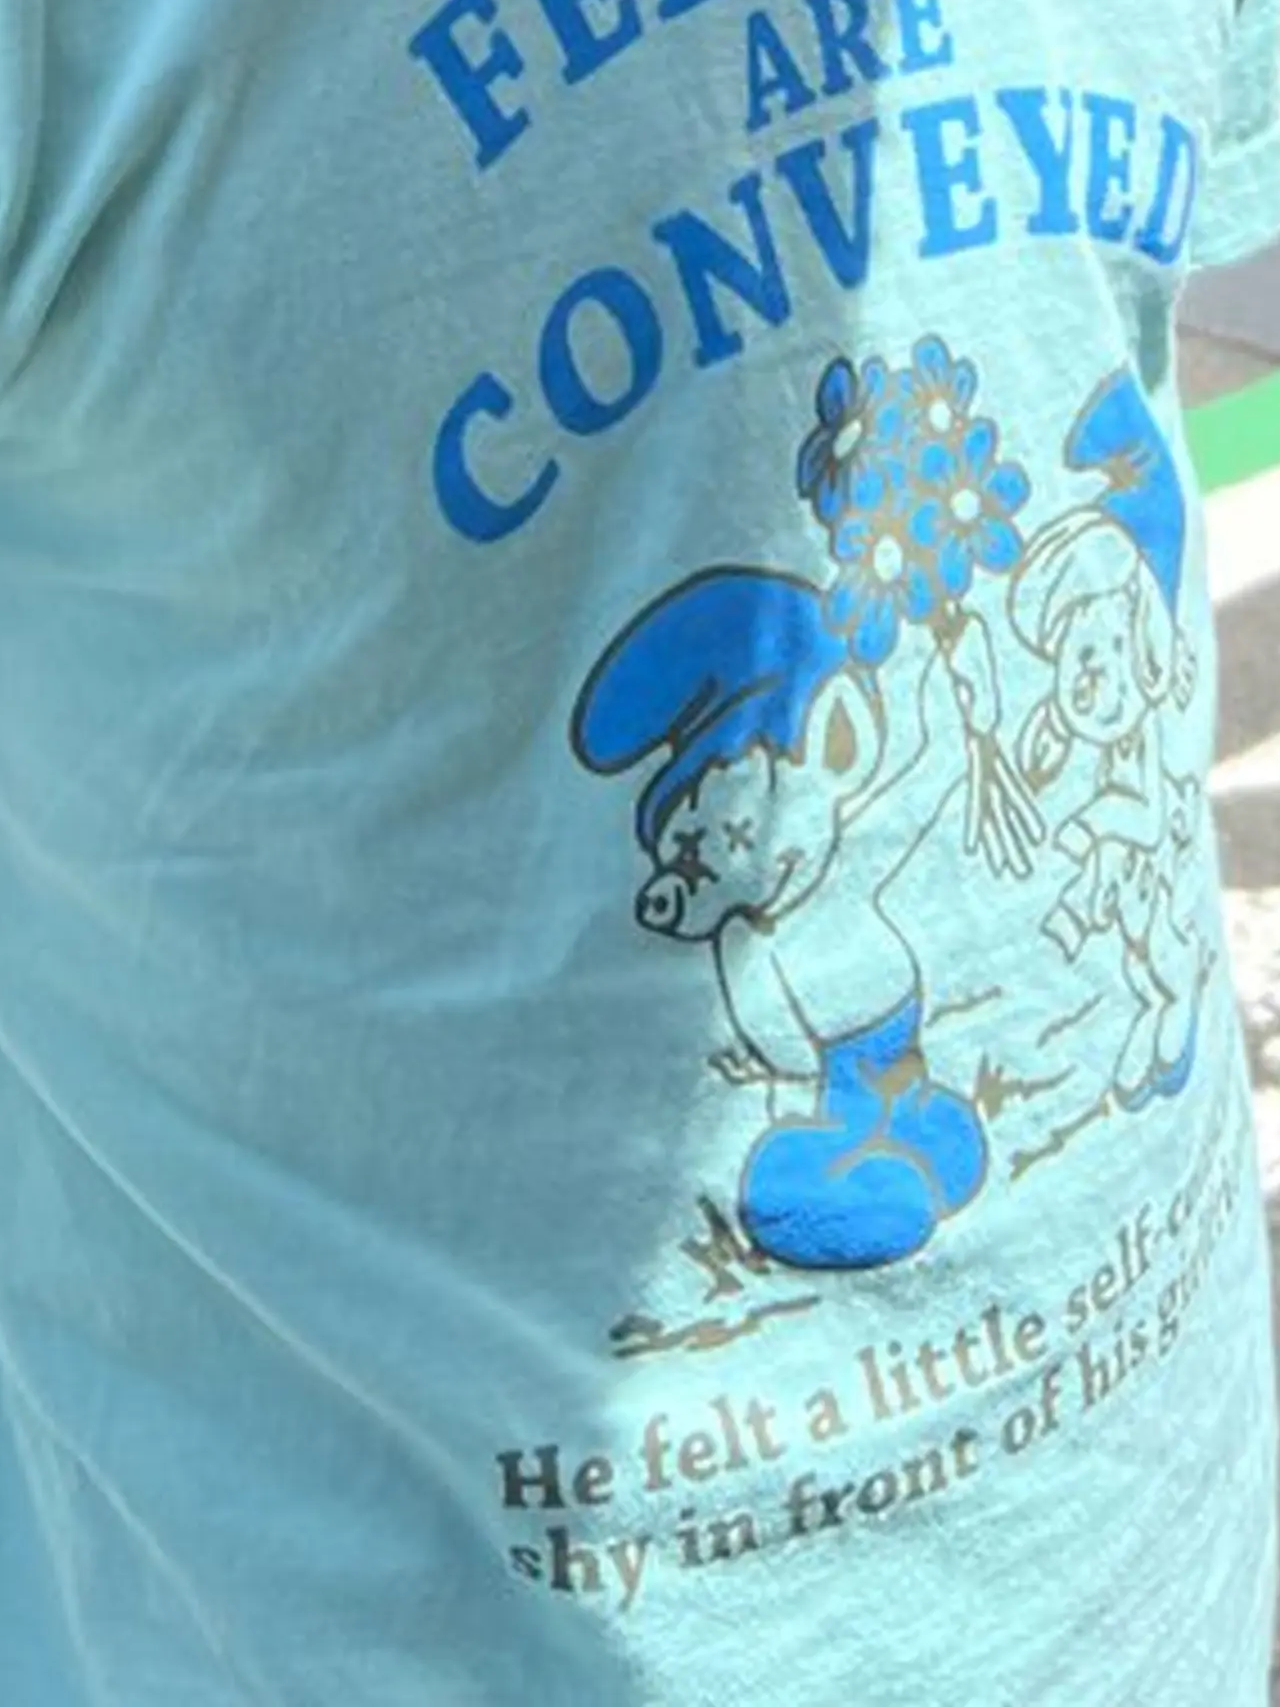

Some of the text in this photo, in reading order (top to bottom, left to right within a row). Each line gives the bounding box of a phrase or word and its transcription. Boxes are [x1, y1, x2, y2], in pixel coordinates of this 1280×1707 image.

[431, 85, 1202, 546] CONVEYED
[494, 1440, 615, 1511] He
[638, 1390, 785, 1493] felt
[805, 1383, 849, 1443] a
[857, 1303, 1048, 1428] little
[507, 1317, 1153, 1613] shy in front of his
